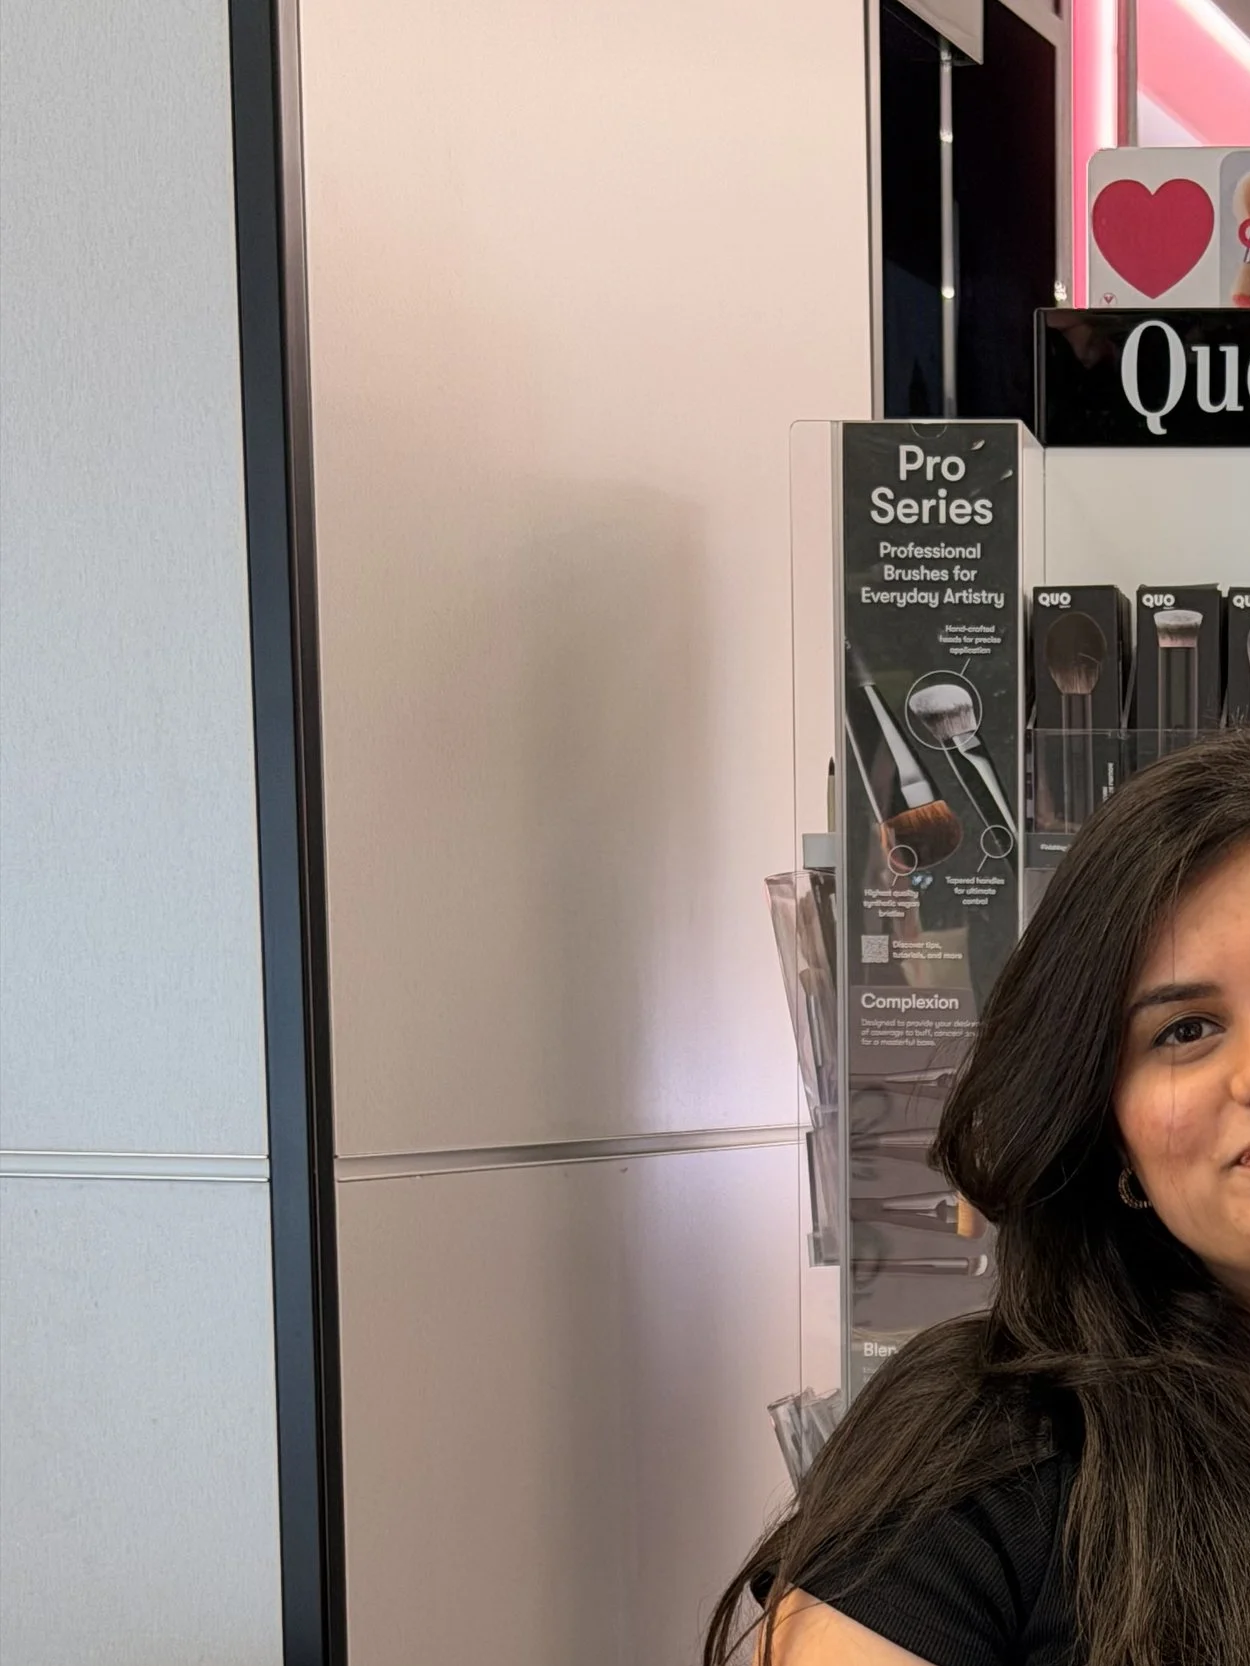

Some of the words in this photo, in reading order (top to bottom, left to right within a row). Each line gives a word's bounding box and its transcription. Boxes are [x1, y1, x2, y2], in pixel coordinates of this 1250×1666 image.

[898, 444, 966, 482] Pro
[870, 486, 993, 525] Series
[879, 541, 982, 560] Professional
[883, 564, 949, 582] Brushes
[952, 565, 978, 582] for
[860, 586, 940, 608] Everyday
[943, 587, 1006, 609] Artistry
[1038, 592, 1072, 607] QUO
[1142, 594, 1176, 608] QUO
[861, 993, 959, 1013] Complexion
